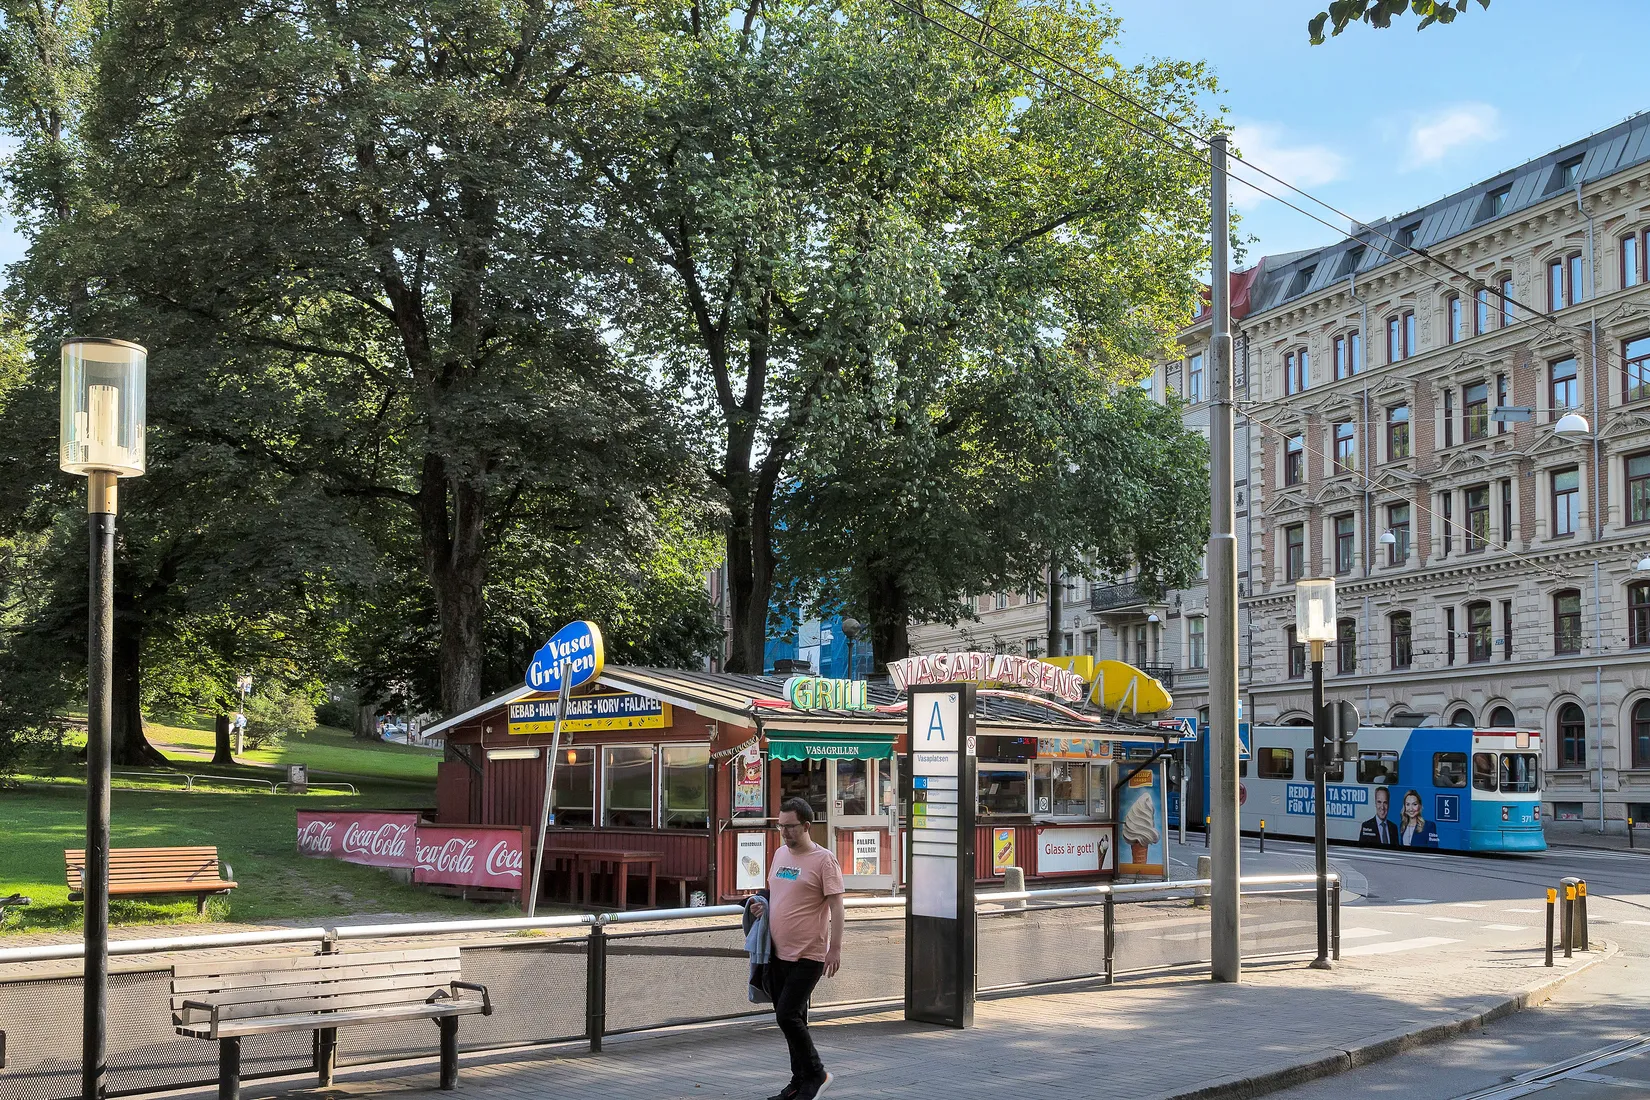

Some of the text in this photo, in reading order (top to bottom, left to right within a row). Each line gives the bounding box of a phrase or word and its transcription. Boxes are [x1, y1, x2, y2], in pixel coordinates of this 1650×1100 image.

[548, 633, 591, 660] Vasa
[889, 652, 1084, 702] VASAPLATSENS
[790, 676, 876, 711] GRILL
[510, 695, 661, 719] KEBAB HAMRGARE KORV FALAFEL
[927, 701, 945, 741] A
[805, 746, 859, 755] VASAGRILLEN
[917, 754, 949, 764] Vasaplatsen
[922, 779, 927, 788] 3
[1288, 786, 1309, 799] REDO
[1328, 788, 1339, 801] TA
[1341, 789, 1367, 802] STRID
[1288, 799, 1353, 816] FÖR VÄÄRDEN
[1521, 815, 1532, 823] 371
[342, 821, 410, 858] Coca-Cola
[1045, 842, 1095, 856] Glass är gott!
[415, 837, 478, 874] oca-Cola
